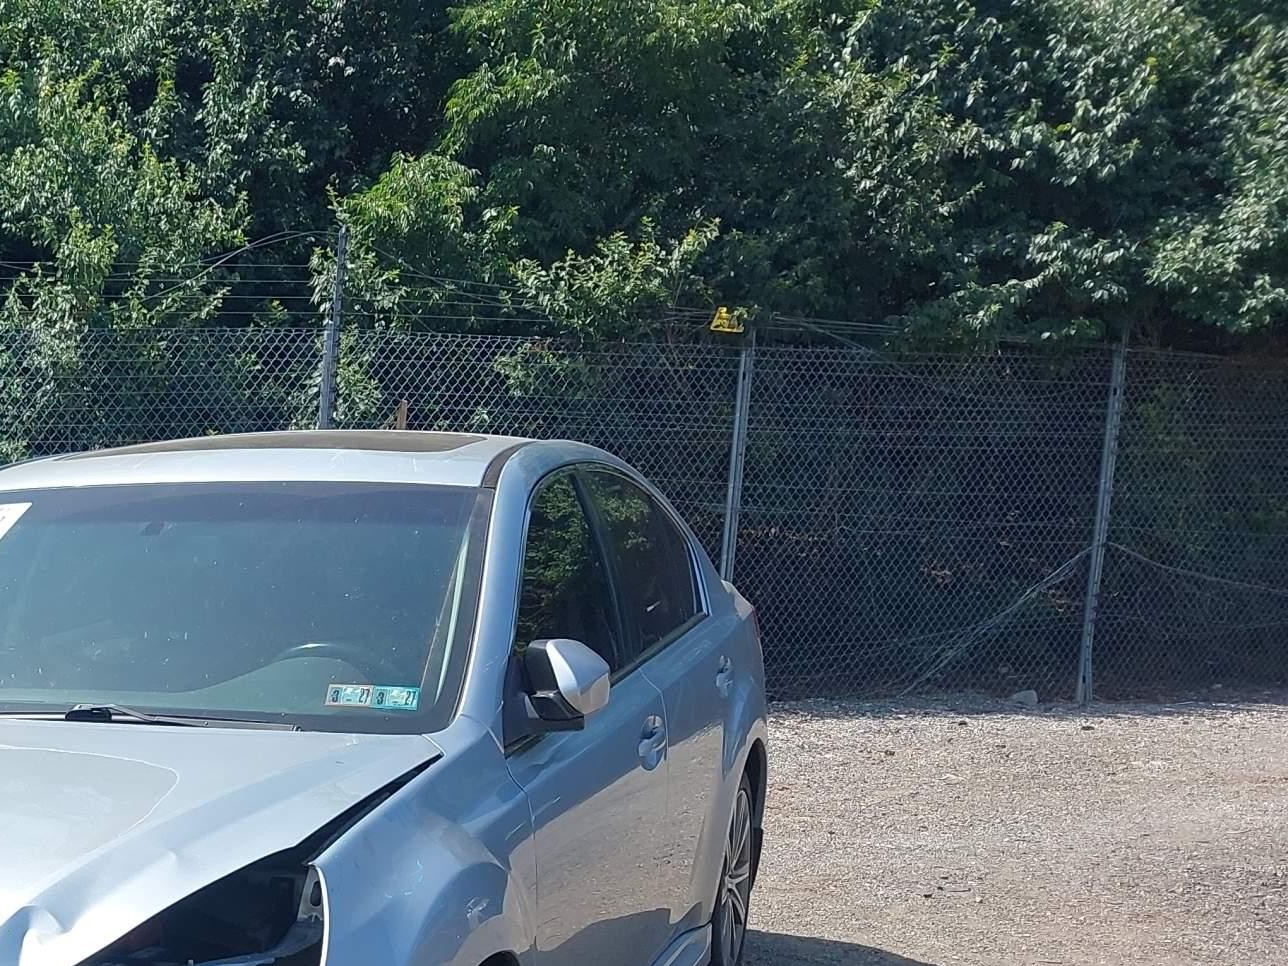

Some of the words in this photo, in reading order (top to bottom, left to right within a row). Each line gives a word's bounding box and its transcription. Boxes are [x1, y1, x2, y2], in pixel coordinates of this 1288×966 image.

[330, 689, 340, 703] 3
[359, 688, 371, 704] 27
[376, 691, 385, 705] 3
[404, 690, 417, 706] 27
